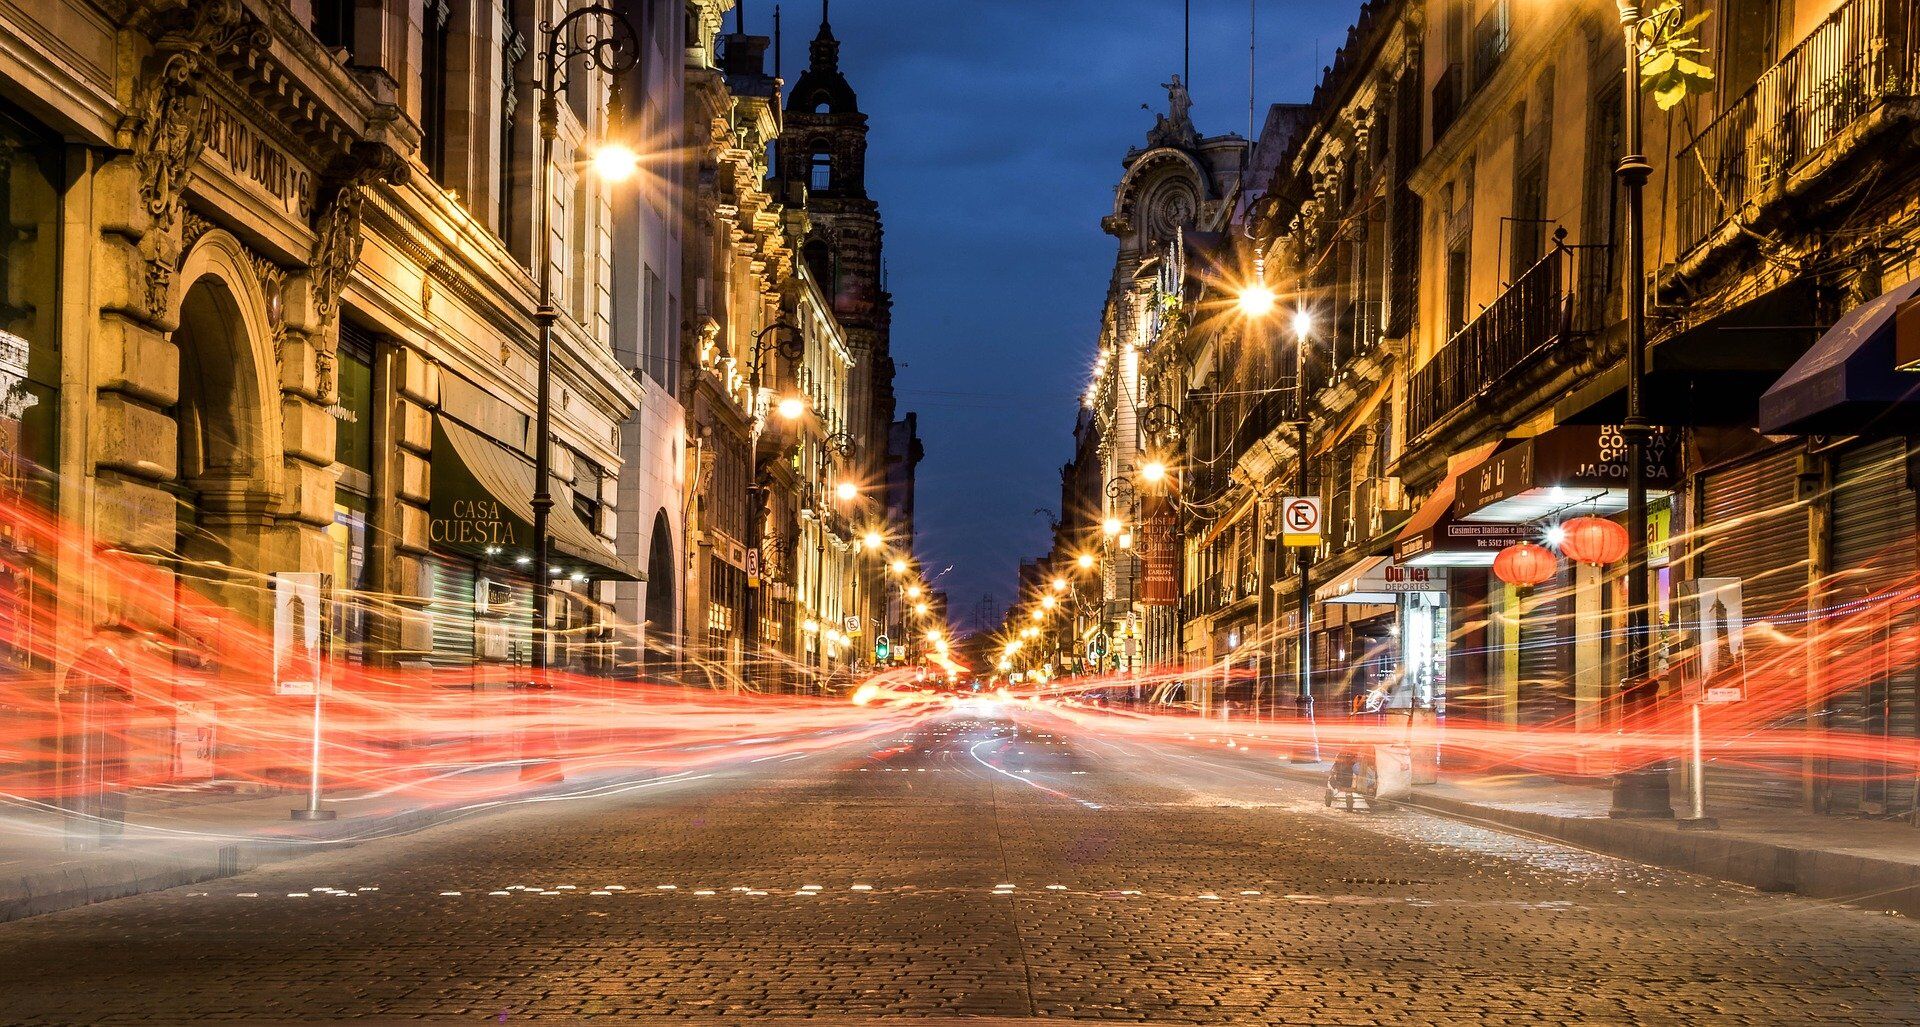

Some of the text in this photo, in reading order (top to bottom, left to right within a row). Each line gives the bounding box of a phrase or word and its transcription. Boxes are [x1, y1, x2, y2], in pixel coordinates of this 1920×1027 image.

[1575, 463, 1669, 478] JAPONSA
[454, 500, 499, 519] CASA
[430, 519, 516, 544] CUESTA
[1451, 526, 1481, 534] Casimires
[1482, 526, 1510, 534] Italianos
[1648, 515, 1658, 542] ai
[1488, 539, 1502, 547] 5512
[1385, 565, 1430, 583] Oulet
[1385, 583, 1430, 591] DEPORTES
